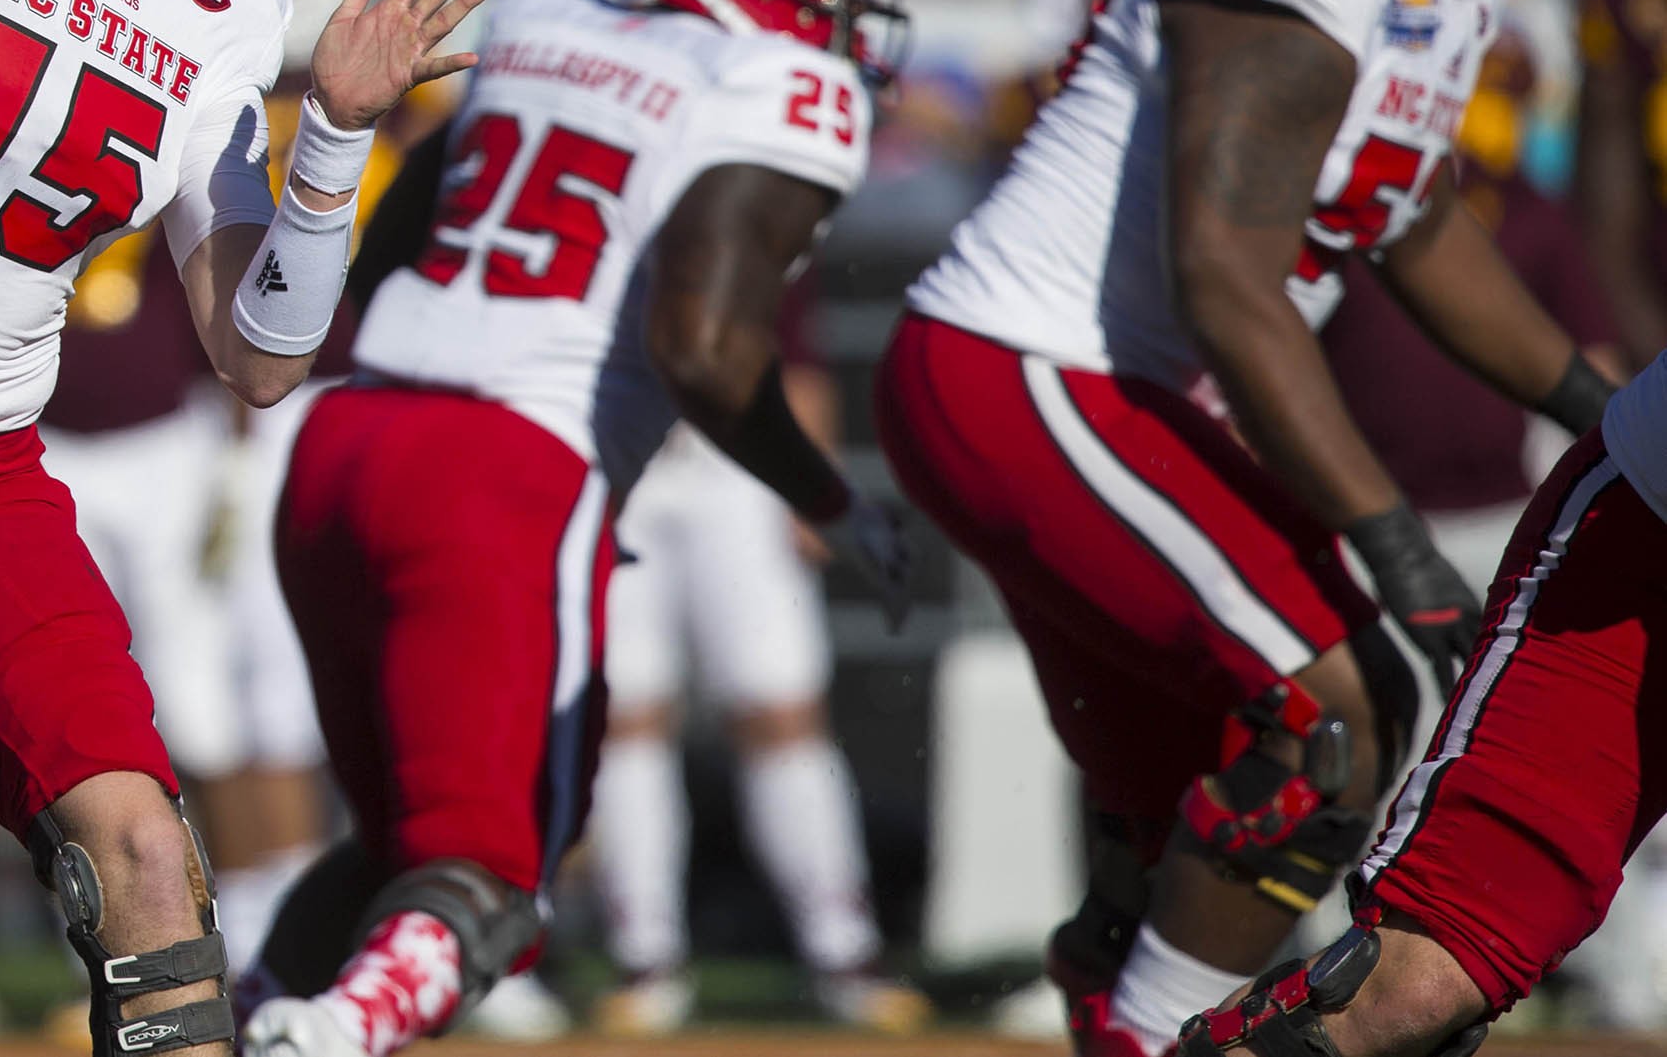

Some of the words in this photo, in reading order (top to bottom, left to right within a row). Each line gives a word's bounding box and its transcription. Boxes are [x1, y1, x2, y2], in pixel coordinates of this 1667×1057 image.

[785, 70, 854, 146] 25
[1376, 74, 1428, 125] NC
[414, 110, 637, 302] 25
[128, 1024, 180, 1043] DONJOY
